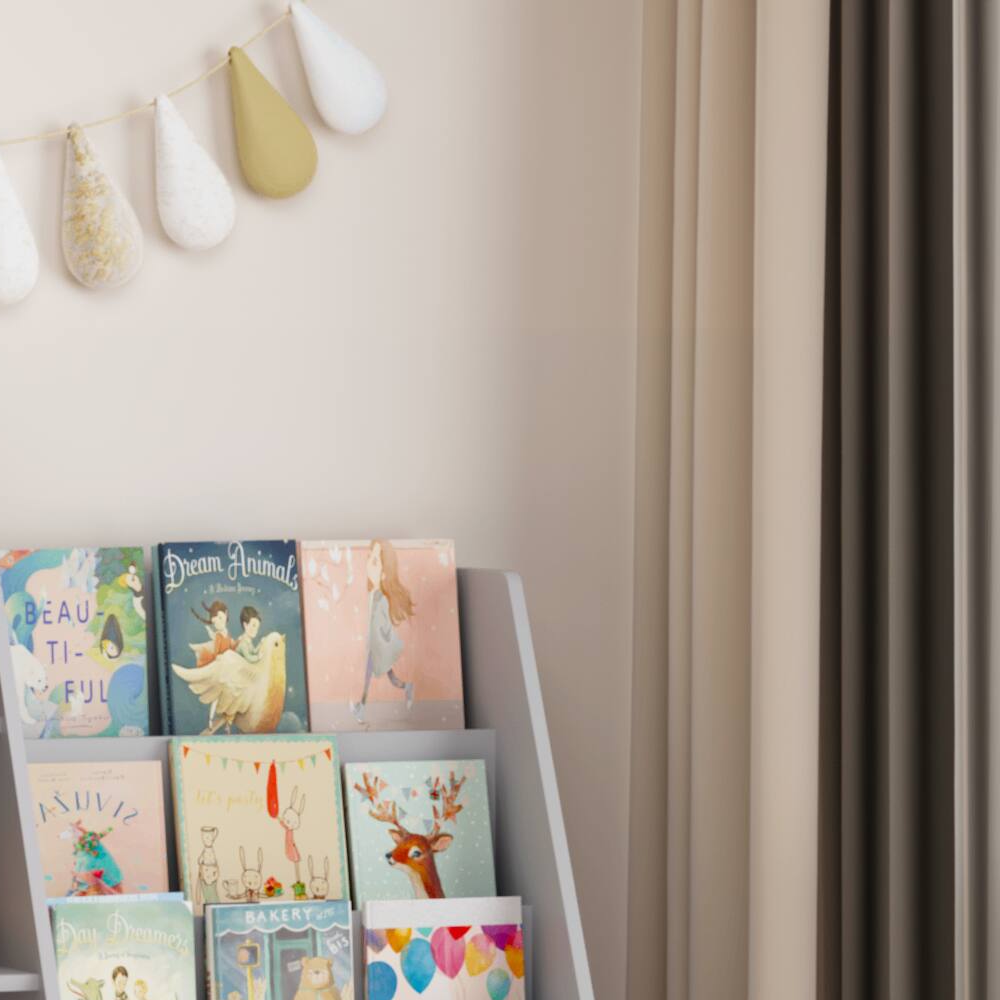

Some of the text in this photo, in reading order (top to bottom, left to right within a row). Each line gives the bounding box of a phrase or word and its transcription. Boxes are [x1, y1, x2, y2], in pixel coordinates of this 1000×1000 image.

[162, 540, 298, 594] Dream Animals
[24, 600, 104, 625] BEAU-
[46, 640, 83, 664] TI-
[65, 680, 108, 704] FUL
[245, 908, 313, 923] BAKERY
[106, 908, 189, 955] Dreamers
